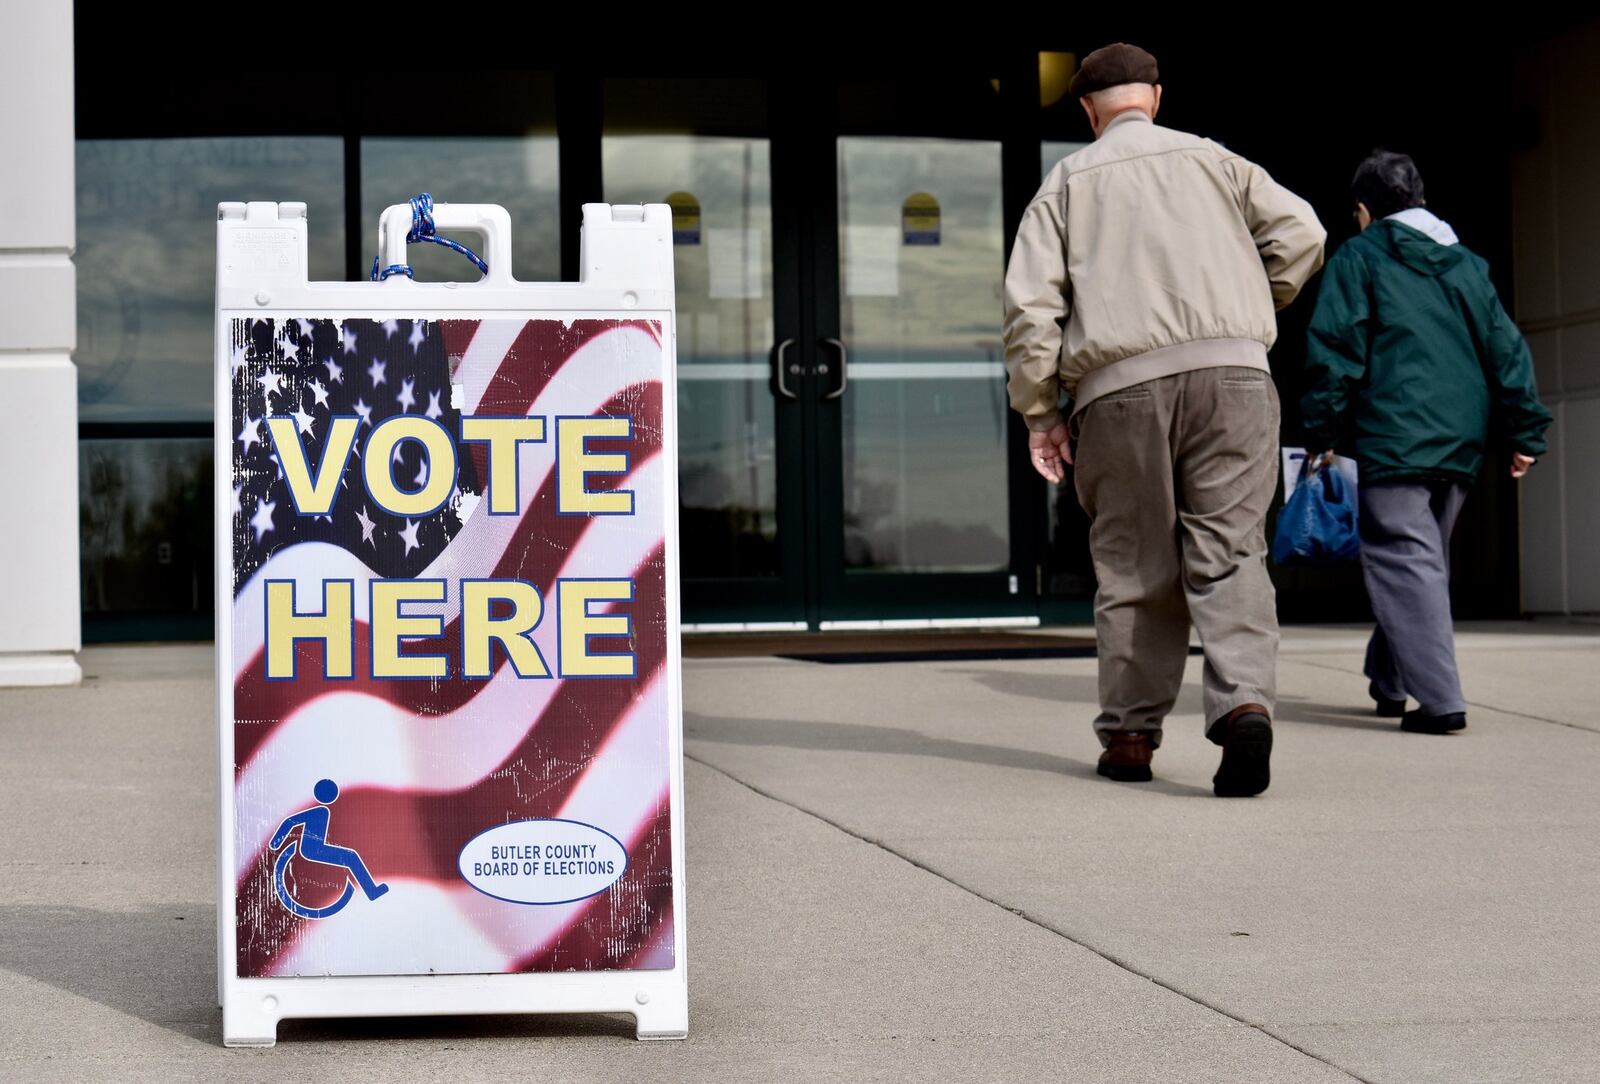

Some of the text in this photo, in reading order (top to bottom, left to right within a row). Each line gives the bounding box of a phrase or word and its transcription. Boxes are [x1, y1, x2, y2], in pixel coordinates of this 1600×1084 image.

[264, 414, 636, 517] VOTE
[264, 577, 638, 681] HERE
[474, 861, 615, 877] BOARD OF ELECTIONS
[491, 844, 597, 860] BUTLER COUNTY
